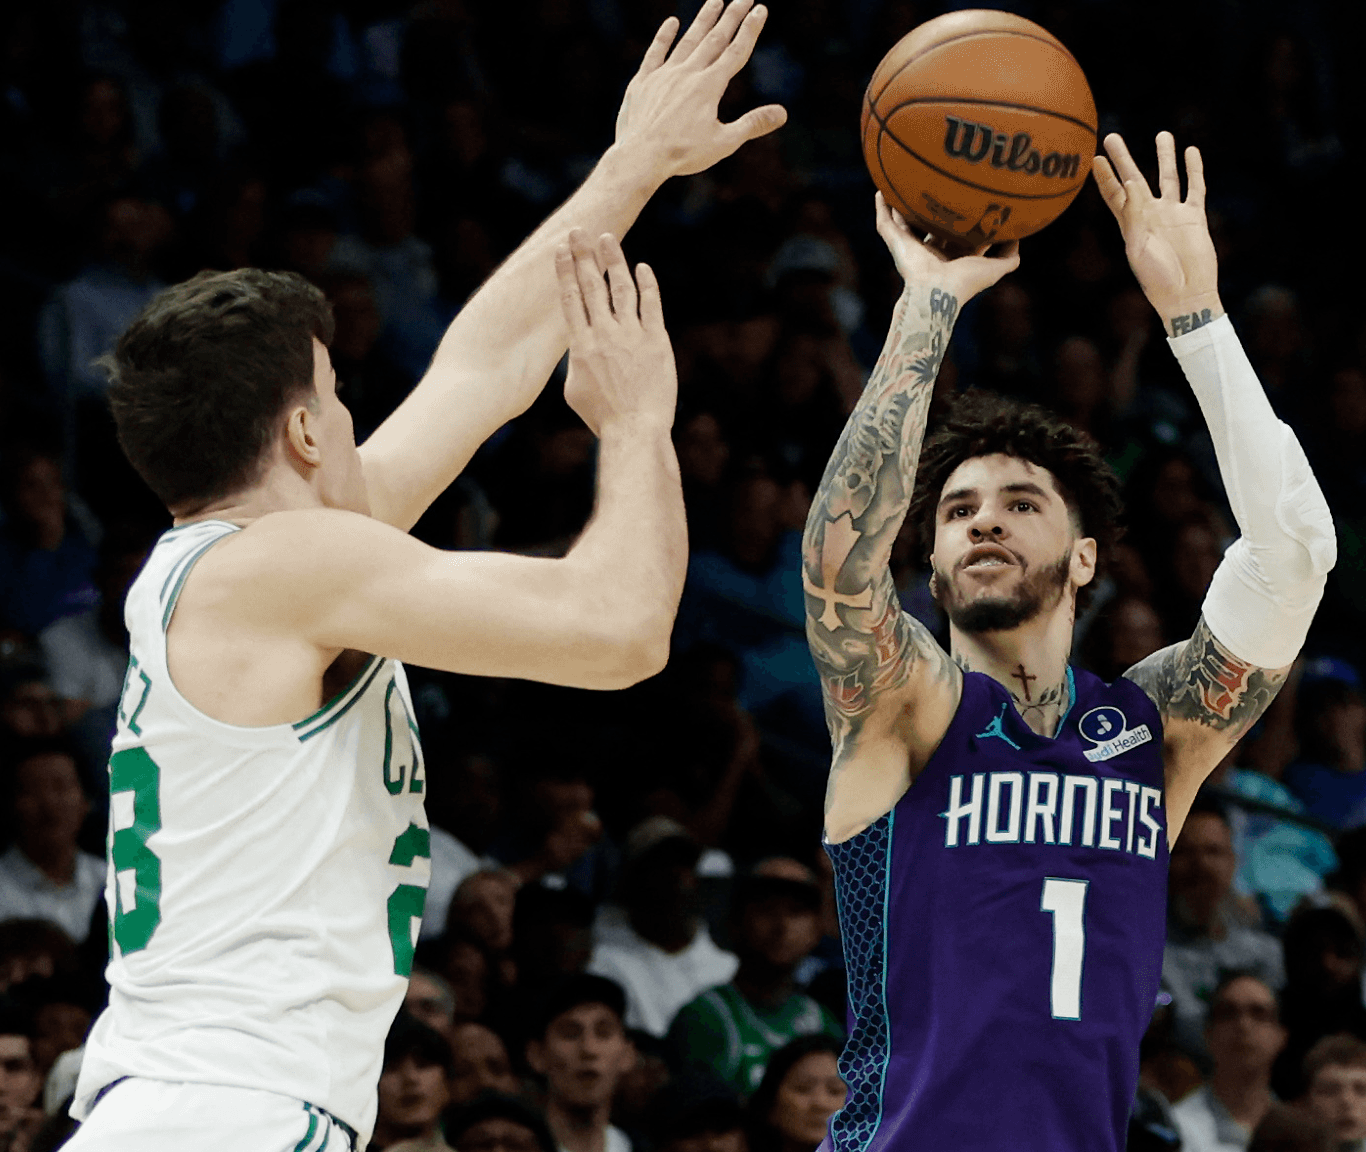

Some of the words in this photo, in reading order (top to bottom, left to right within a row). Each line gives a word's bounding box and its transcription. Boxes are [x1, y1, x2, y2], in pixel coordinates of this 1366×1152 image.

[945, 115, 1081, 178] Wilson
[1112, 727, 1151, 753] Health
[938, 771, 1163, 860] HORNETS
[1040, 877, 1089, 1021] 1
